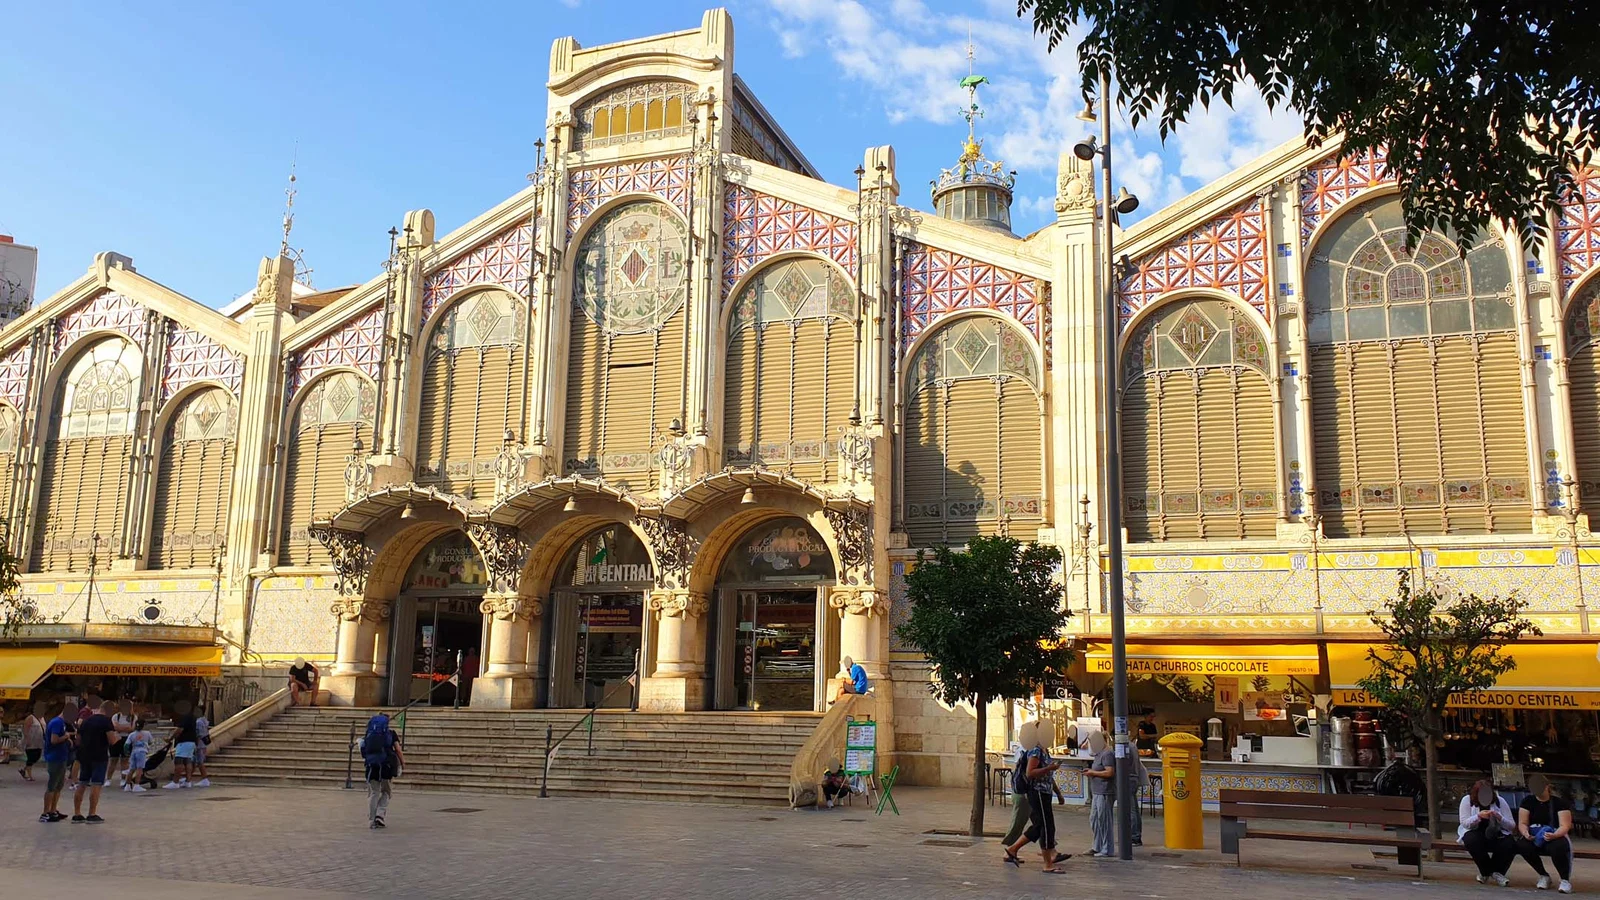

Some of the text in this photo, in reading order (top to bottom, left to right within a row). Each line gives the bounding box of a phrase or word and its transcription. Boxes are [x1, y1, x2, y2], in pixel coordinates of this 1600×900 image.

[796, 543, 827, 552] LOCAL
[435, 554, 472, 563] RODUCTE
[598, 563, 654, 583] CENTRAL
[55, 664, 109, 673] ESPECIALIDAD
[110, 665, 121, 673] EN
[122, 665, 151, 674] DATILES
[152, 666, 158, 674] Y
[160, 665, 198, 674] TURRONES
[1097, 660, 1269, 672] HOHATA CHURROS CHOCOLATE
[1343, 692, 1365, 703] LAS
[1451, 693, 1515, 705] MERCADO
[1518, 694, 1579, 706] CENTRAL
